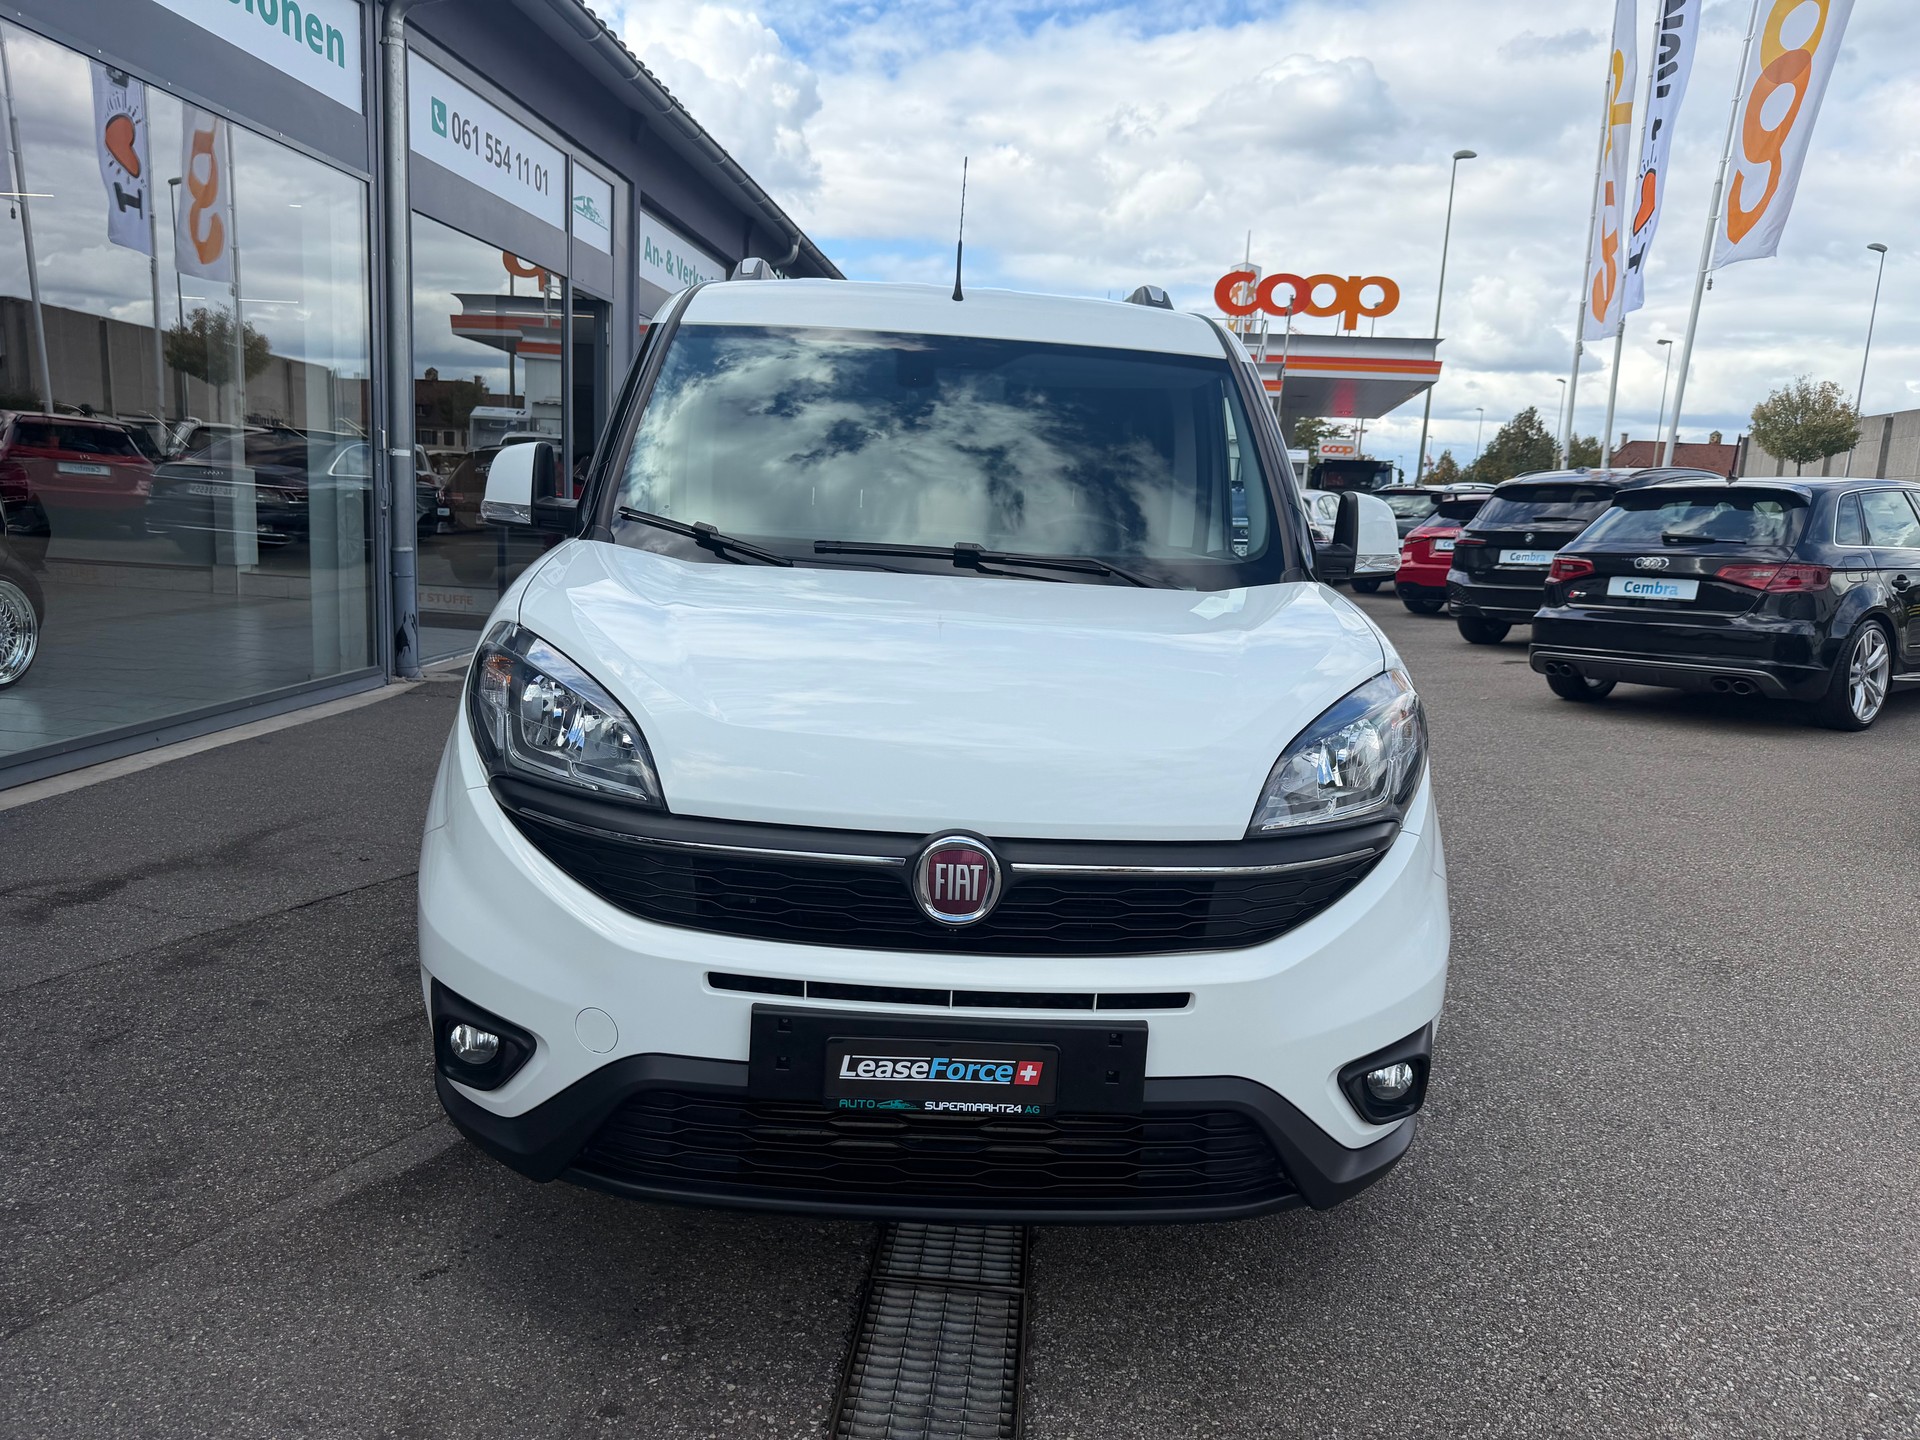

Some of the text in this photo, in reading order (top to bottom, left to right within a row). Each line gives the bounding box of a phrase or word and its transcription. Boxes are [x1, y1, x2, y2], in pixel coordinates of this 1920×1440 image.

[228, 0, 345, 69] onen
[452, 112, 548, 196] 061 554 11 01
[644, 235, 663, 268] An-
[665, 249, 674, 276] &
[1214, 271, 1400, 331] coop
[1321, 444, 1354, 456] coop
[1510, 552, 1546, 562] Cembra
[1624, 581, 1679, 596] Cembra
[935, 863, 984, 901] FIAT
[839, 1055, 1014, 1082] LeaseForce
[839, 1099, 1041, 1114] AUTO SUPERMARKT24 AG
